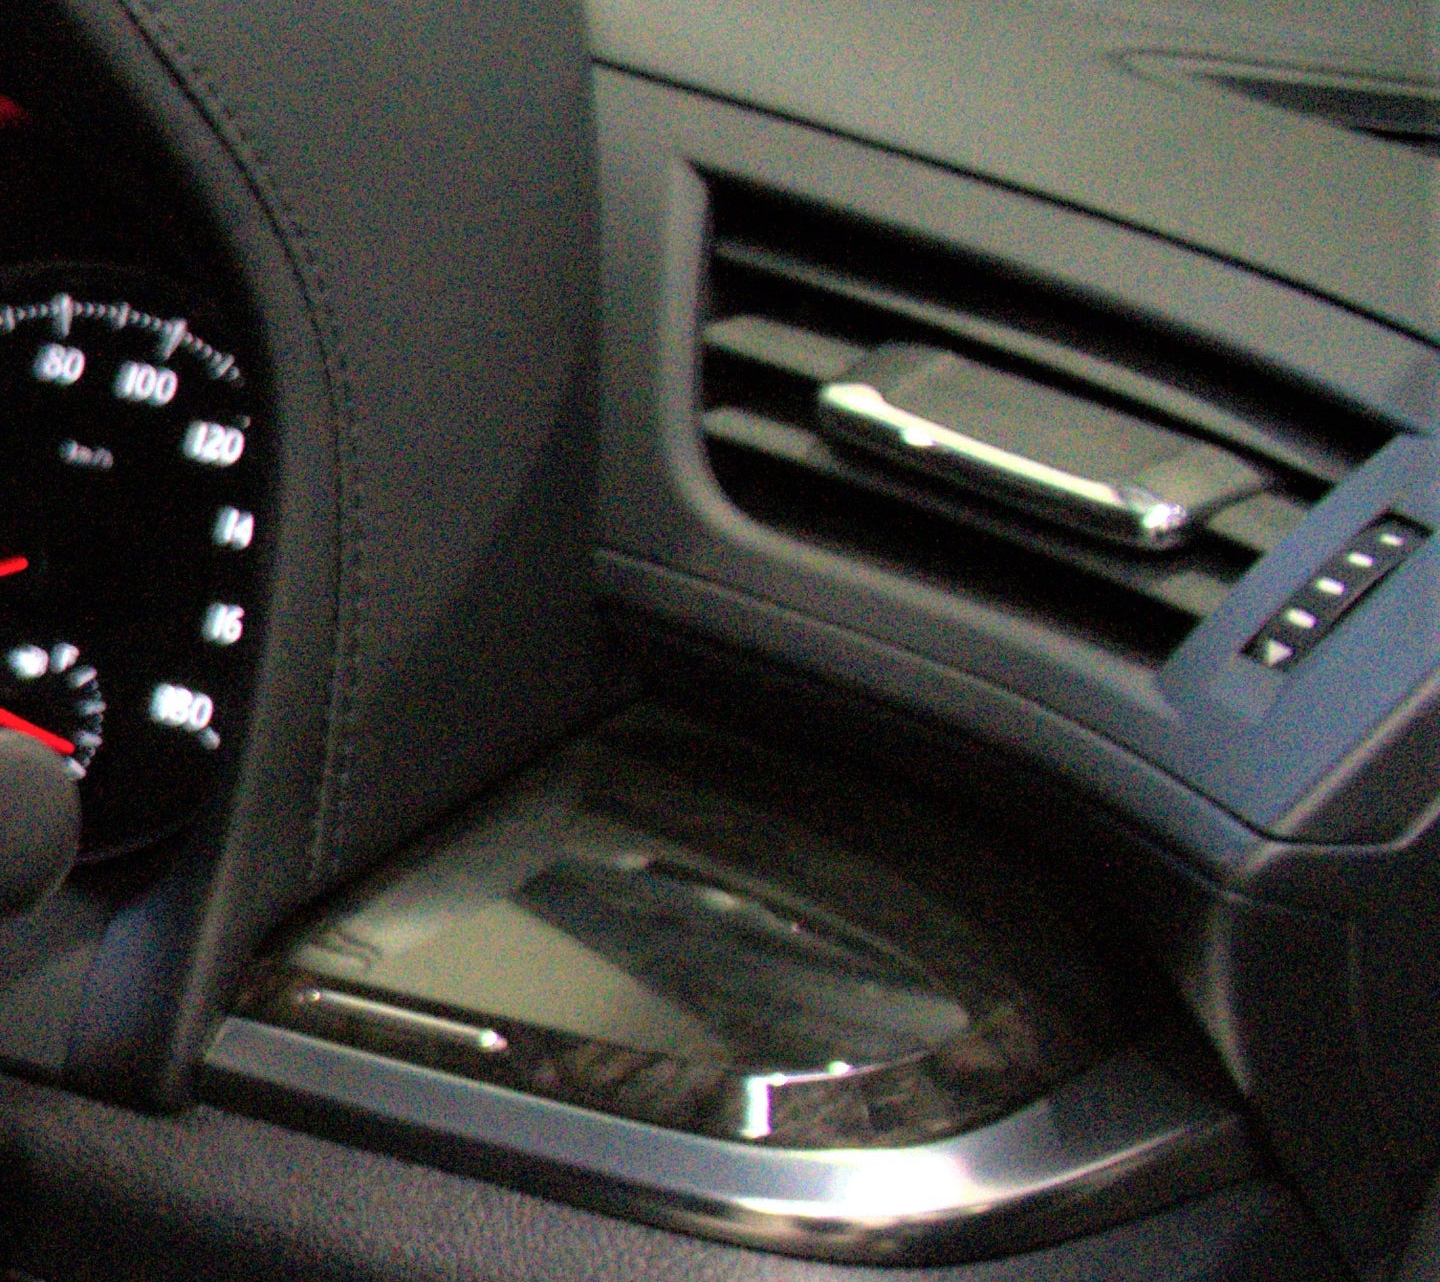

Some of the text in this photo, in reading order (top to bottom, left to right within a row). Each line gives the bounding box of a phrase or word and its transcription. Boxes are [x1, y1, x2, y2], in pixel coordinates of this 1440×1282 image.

[33, 343, 85, 385] 80
[113, 361, 178, 406] 100
[184, 421, 245, 466] 120
[214, 506, 254, 549] 14
[203, 602, 246, 645] 16
